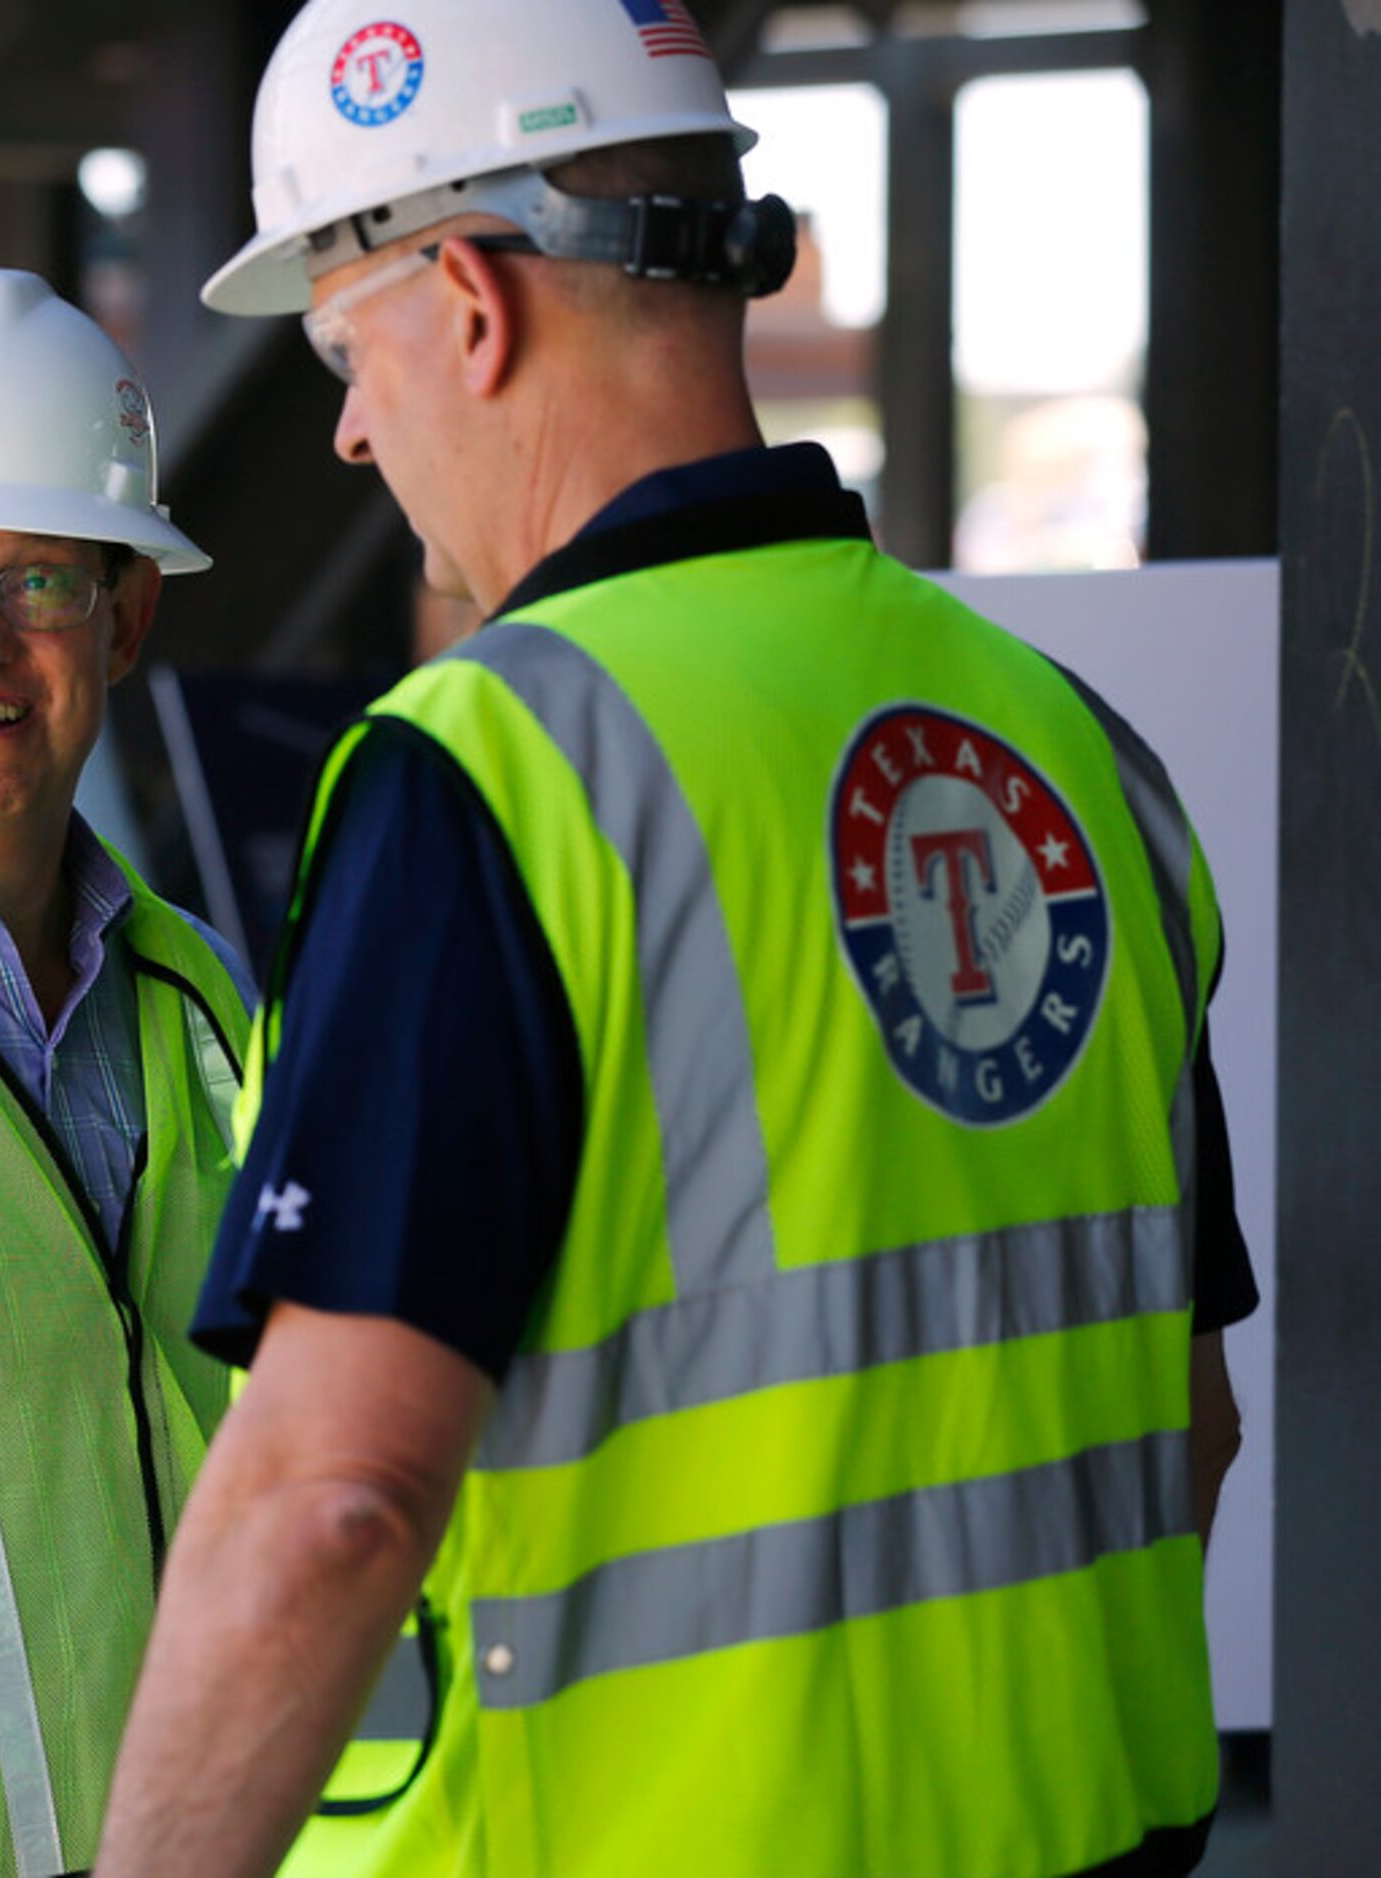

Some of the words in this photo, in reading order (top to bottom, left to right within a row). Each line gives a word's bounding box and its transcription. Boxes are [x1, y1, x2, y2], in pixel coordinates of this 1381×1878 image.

[355, 49, 390, 94] T
[849, 726, 1030, 828] TEXAS
[909, 828, 997, 1006] T
[872, 933, 1093, 1102] RANGERS
